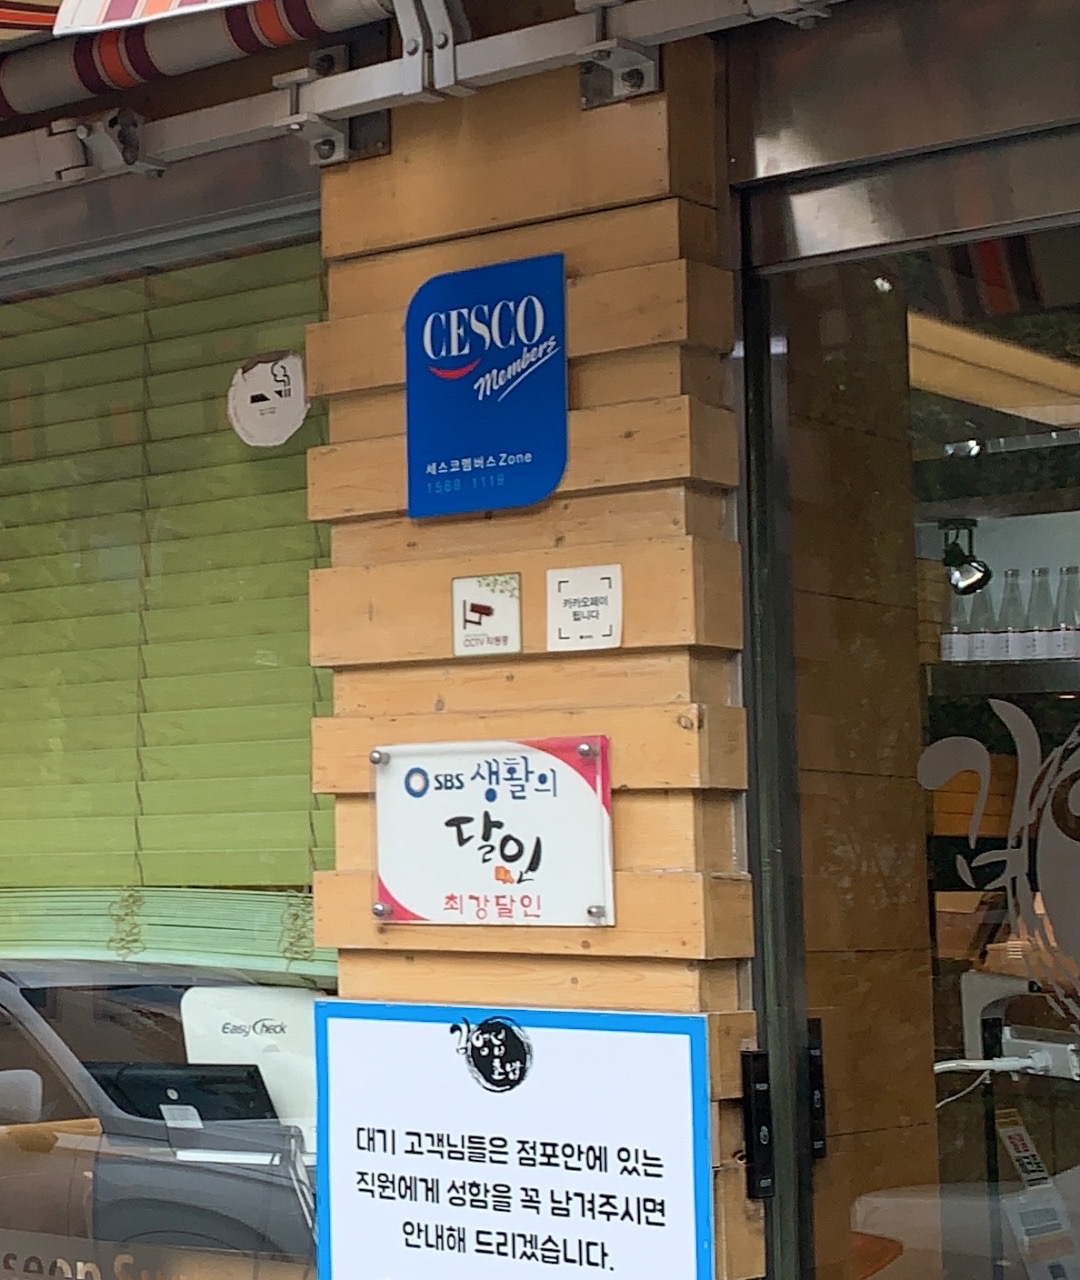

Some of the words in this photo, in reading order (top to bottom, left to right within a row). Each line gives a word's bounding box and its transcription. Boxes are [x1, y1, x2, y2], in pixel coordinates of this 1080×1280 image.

[422, 295, 545, 360] CESCO
[473, 335, 557, 400] Members
[563, 595, 608, 609] 카카오페이
[434, 773, 465, 790] SBS
[470, 755, 558, 803] 생활의
[444, 810, 543, 884] 달인
[356, 1126, 396, 1156] 대기
[404, 1130, 509, 1166] 고객님들은
[516, 1139, 608, 1174] 점포안에
[617, 1148, 664, 1178] 있는
[355, 1171, 440, 1205] 직원에게
[446, 1180, 512, 1212] 성함을
[519, 1187, 541, 1214] 꼭
[550, 1192, 666, 1227] 남겨주시면
[402, 1221, 466, 1253] 안내해
[474, 1230, 616, 1272] 드리겠습니다.
